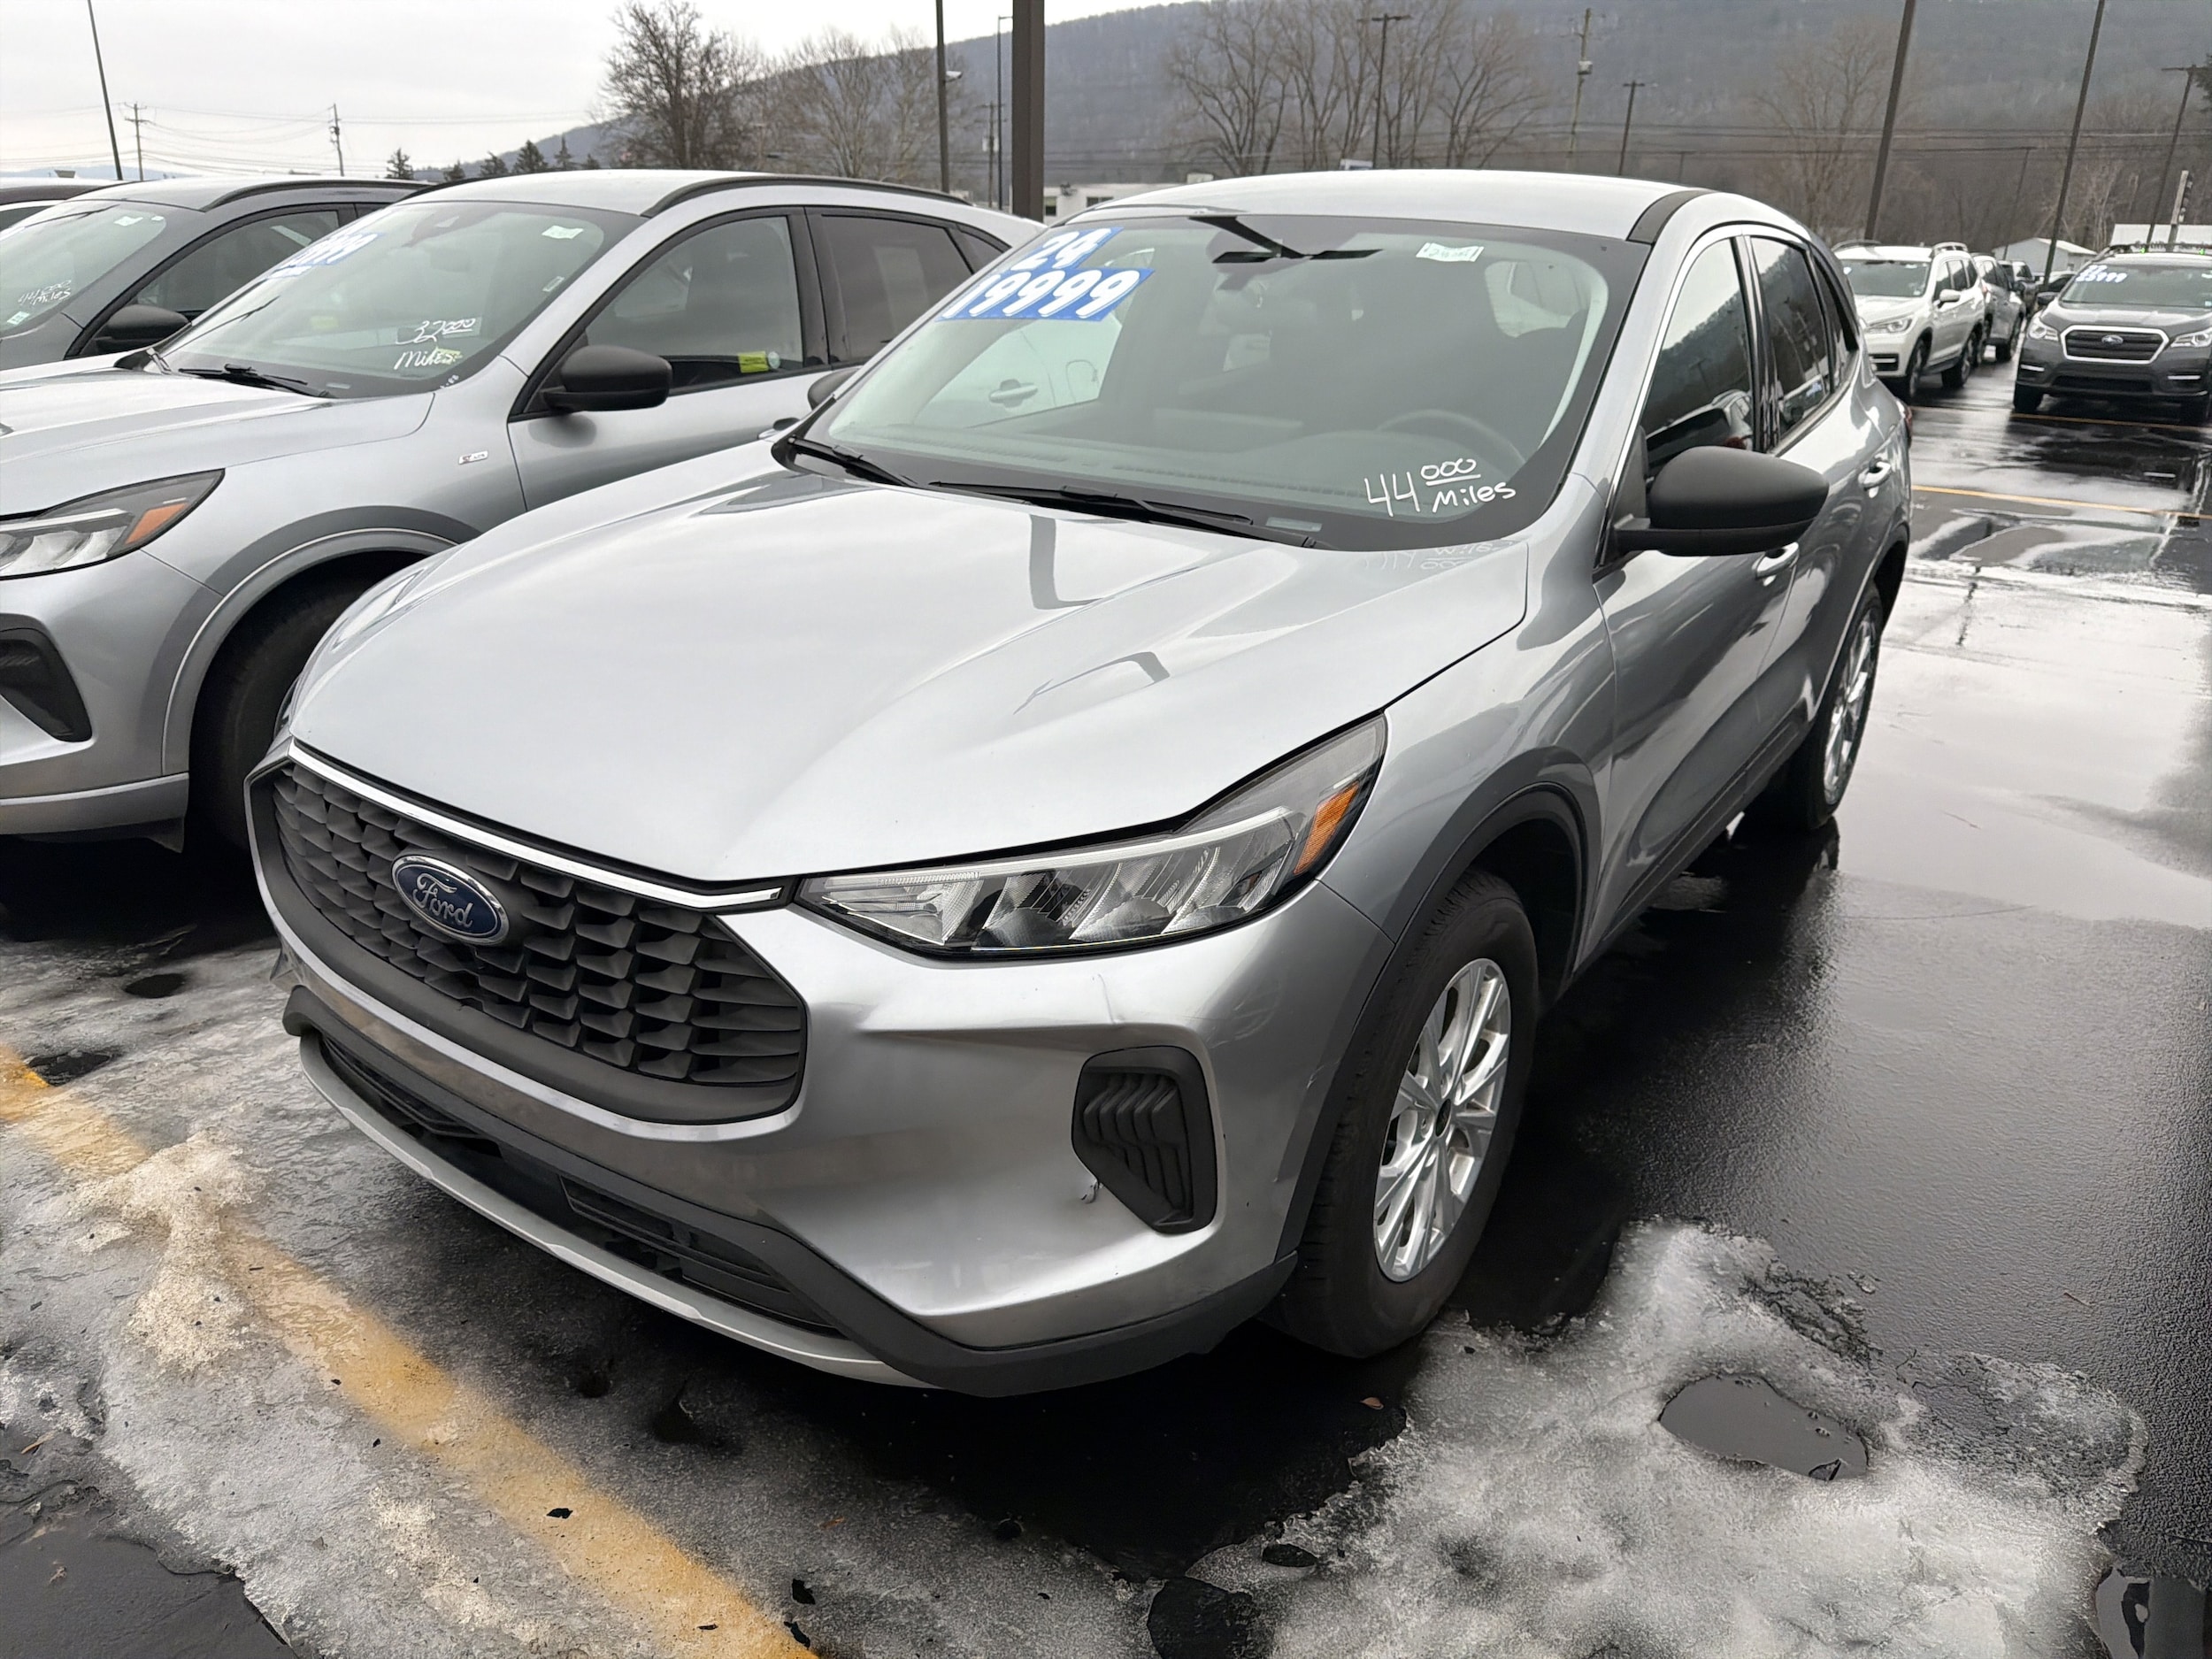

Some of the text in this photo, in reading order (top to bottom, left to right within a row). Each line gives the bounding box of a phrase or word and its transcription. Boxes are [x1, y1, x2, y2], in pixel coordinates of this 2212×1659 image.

[1010, 227, 1112, 270] 24
[941, 269, 1141, 319] 19999
[1432, 481, 1517, 513] Miles
[412, 872, 475, 927] Ford
